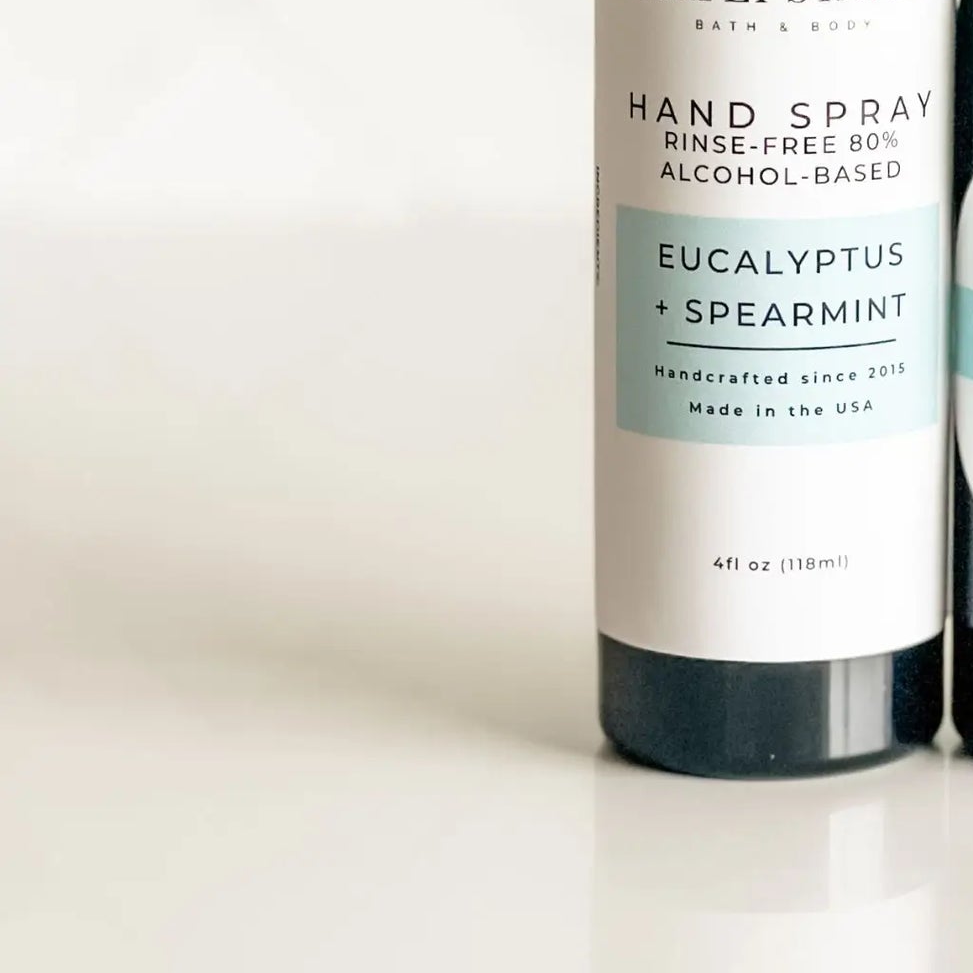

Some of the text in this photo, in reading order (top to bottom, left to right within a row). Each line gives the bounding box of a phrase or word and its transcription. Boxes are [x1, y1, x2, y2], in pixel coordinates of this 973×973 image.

[695, 19, 872, 32] BATH & BODY
[629, 90, 932, 129] HAND SPRAY
[664, 130, 899, 155] RINSE-FREE 80%
[660, 160, 901, 185] ALCOHOL-BASED
[658, 241, 904, 275] EUCALYPTUS
[655, 293, 907, 327] + SPEARMINT
[654, 362, 905, 385] Handcrafted since 2015
[689, 399, 873, 417] Made in the USA
[713, 555, 848, 574] 4fl oz (118ml)
